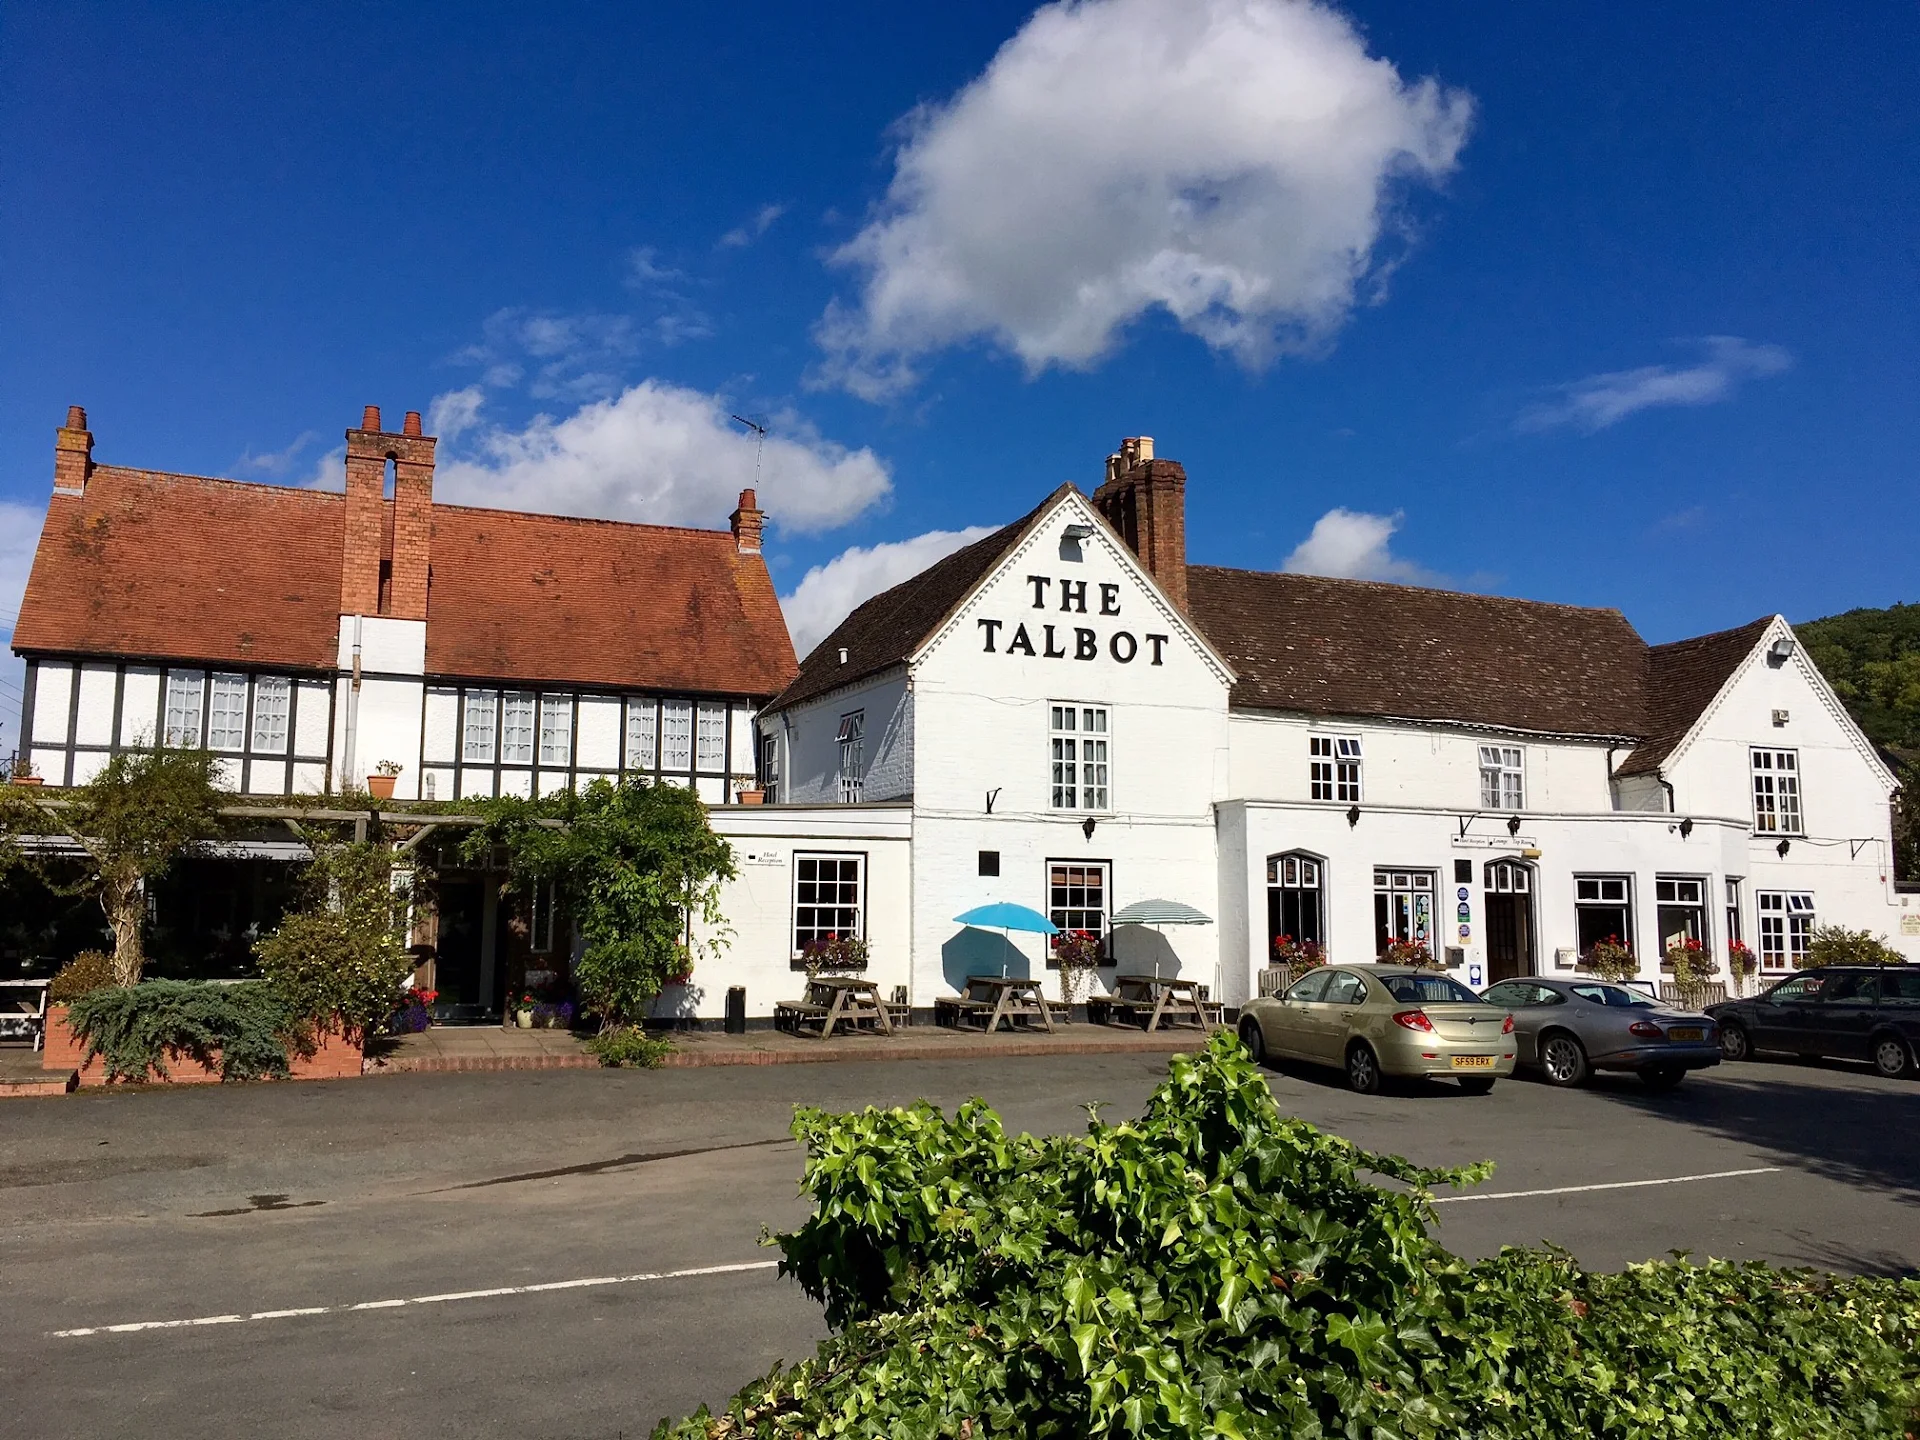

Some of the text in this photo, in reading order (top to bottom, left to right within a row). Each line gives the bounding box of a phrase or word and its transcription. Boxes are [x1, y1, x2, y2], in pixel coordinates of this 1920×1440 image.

[1026, 575, 1121, 616] THE
[977, 619, 1169, 666] TALBOT
[1455, 1057, 1490, 1066] SF59 ERX
